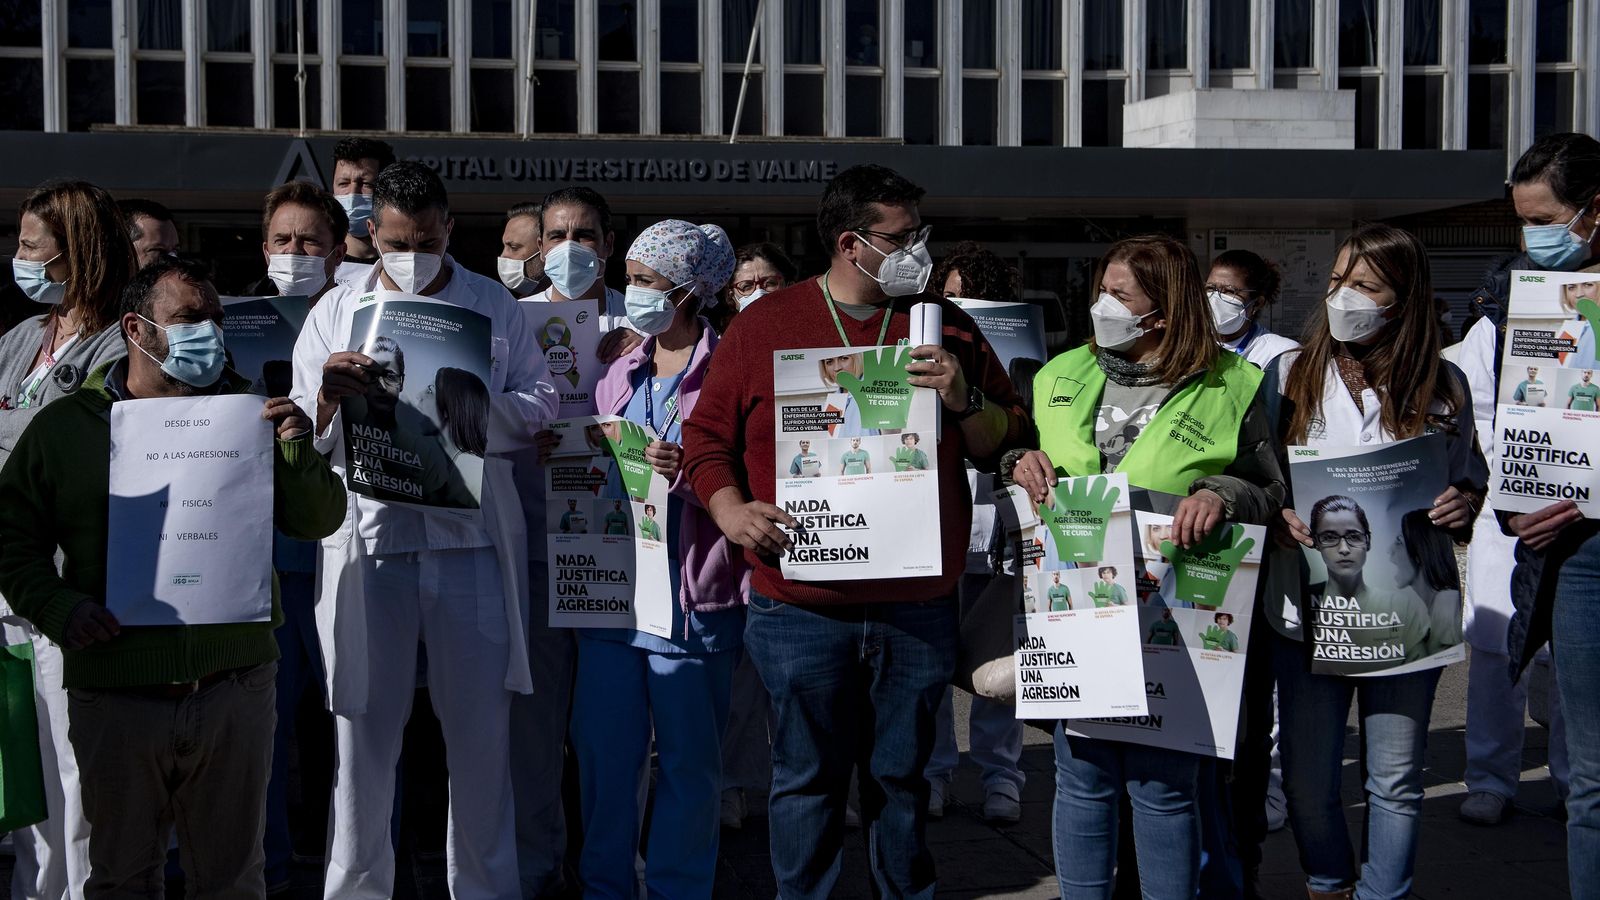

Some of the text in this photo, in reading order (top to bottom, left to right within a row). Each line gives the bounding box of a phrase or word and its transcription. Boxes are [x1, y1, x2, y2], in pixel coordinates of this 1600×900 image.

[504, 157, 710, 181] UNIVERSITARIO
[713, 160, 748, 181] DE
[752, 159, 838, 182] VALME
[395, 316, 420, 325] SUFRIDO
[420, 319, 432, 327] UNA
[420, 325, 442, 334] VERBAL
[566, 392, 588, 400] SALUD
[860, 386, 909, 395] AGRESIONES
[164, 418, 211, 428] DESDE USO
[352, 423, 392, 444] NADA
[1169, 429, 1205, 453] SEVILLA
[1503, 427, 1552, 446] NADA
[146, 450, 240, 461] NO A LAS AGRESIONES
[352, 438, 423, 467] JUSTIFICA
[1502, 445, 1591, 467] JUSTIFICA
[353, 453, 384, 472] UNA
[1502, 461, 1539, 478] UNA
[353, 467, 423, 497] AGRESIÓN
[1499, 478, 1590, 500] AGRESIÓN
[160, 499, 212, 509] NI FISICAS
[785, 499, 831, 514] NADA
[1053, 516, 1103, 525] AGRESIONES
[158, 532, 218, 541] NI VERBALES
[1071, 529, 1093, 537] CUIDA
[556, 554, 597, 567] NADA
[787, 543, 869, 563] AGRESIÓN
[556, 569, 628, 583] JUSTIFICA
[1196, 572, 1218, 582] CUIDA
[556, 583, 588, 596] UNA
[556, 596, 629, 612] AGRESIÓN
[1310, 594, 1361, 611] NADA
[1311, 611, 1402, 627] JUSTIFICA
[1018, 636, 1046, 650] NADA
[1313, 628, 1353, 643] UNA
[1313, 642, 1405, 660] AGRESIÓN
[1020, 651, 1075, 667] JUSTIFICA
[1021, 670, 1043, 683] UNA
[1022, 682, 1080, 700] AGRESIÓN
